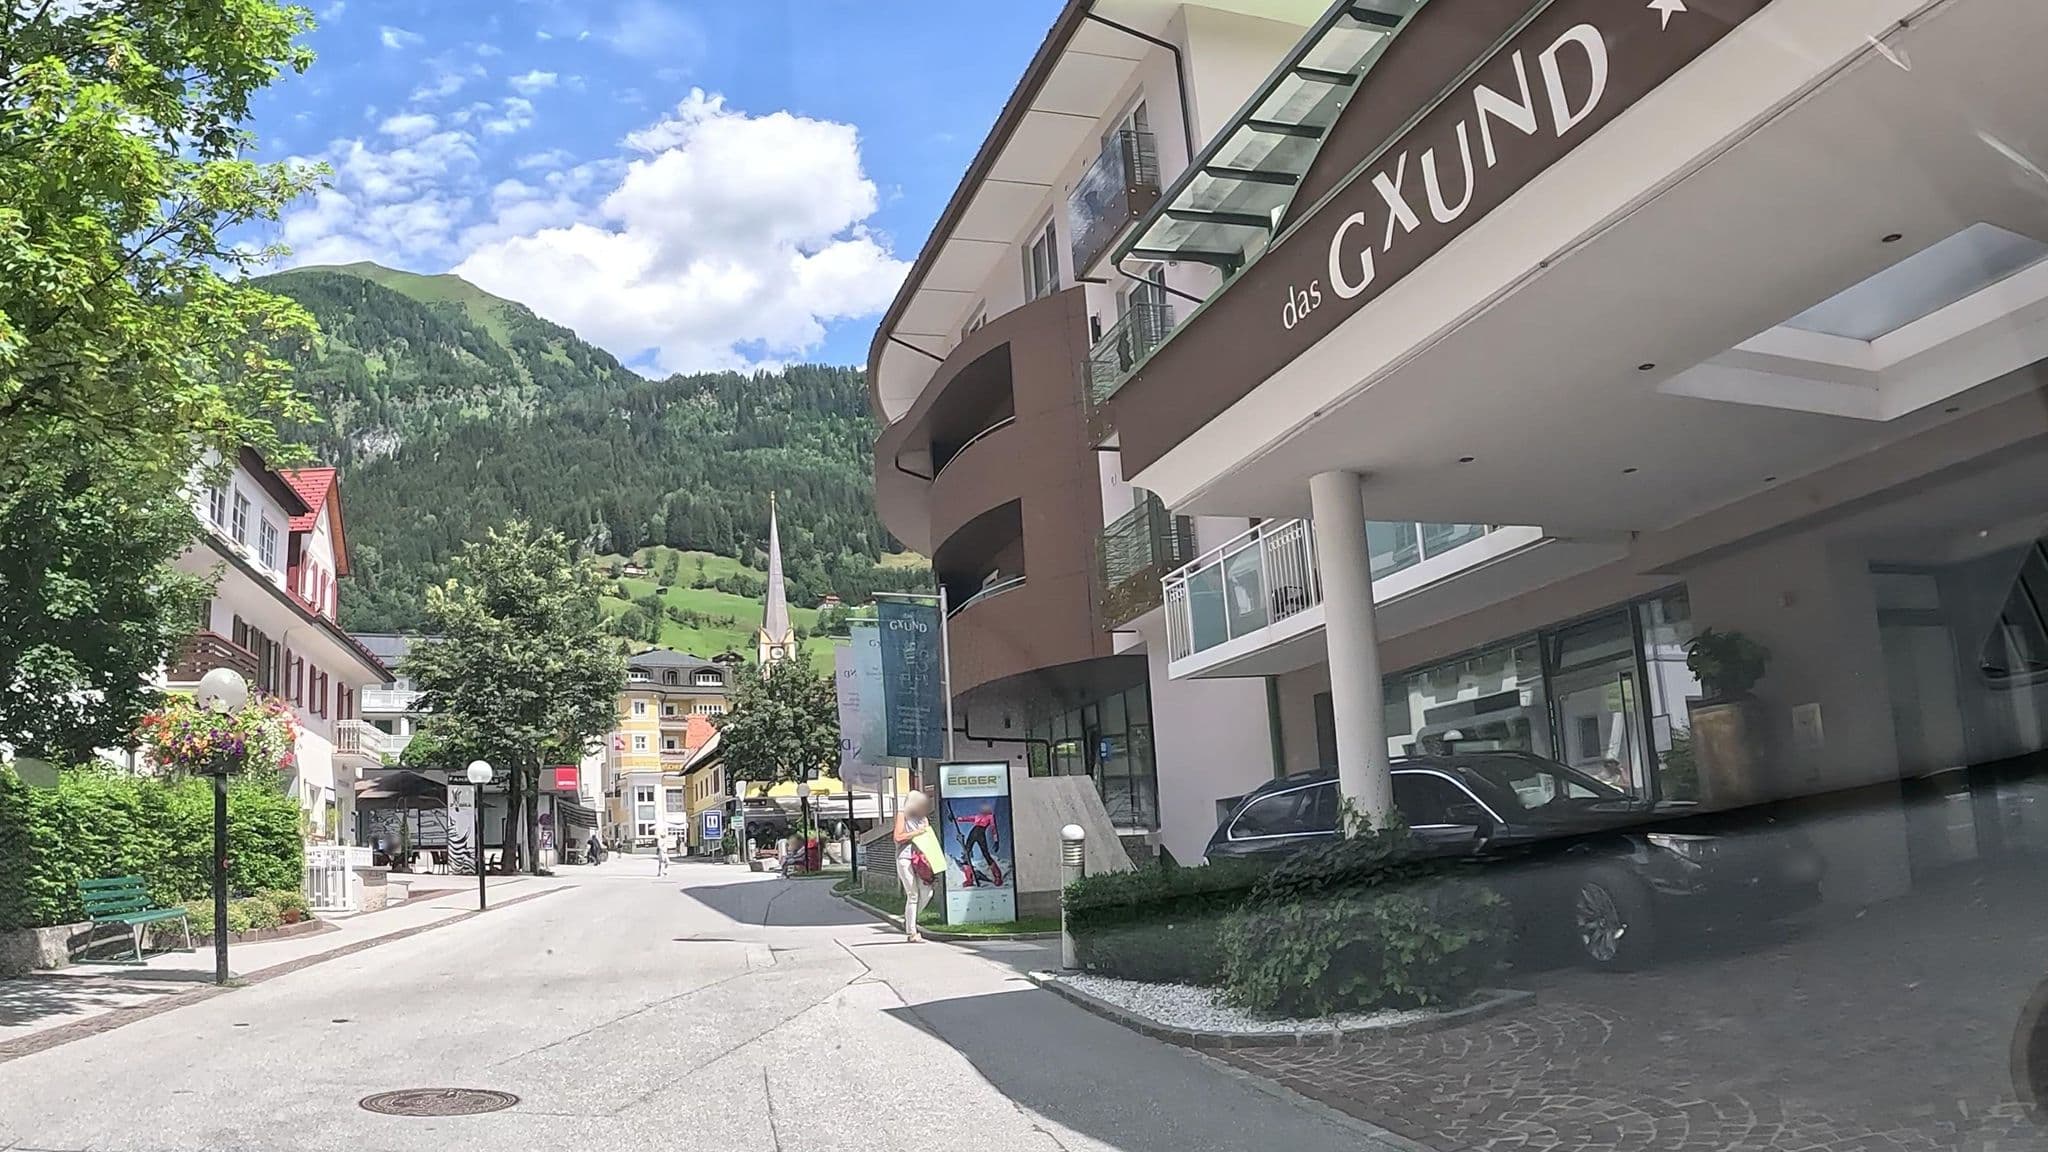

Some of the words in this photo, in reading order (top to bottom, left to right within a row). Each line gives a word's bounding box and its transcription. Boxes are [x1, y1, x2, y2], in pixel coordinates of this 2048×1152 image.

[1283, 279, 1322, 330] das
[1328, 23, 1609, 300] GXUND
[889, 619, 928, 633] GXUND
[947, 775, 998, 786] EGGER
